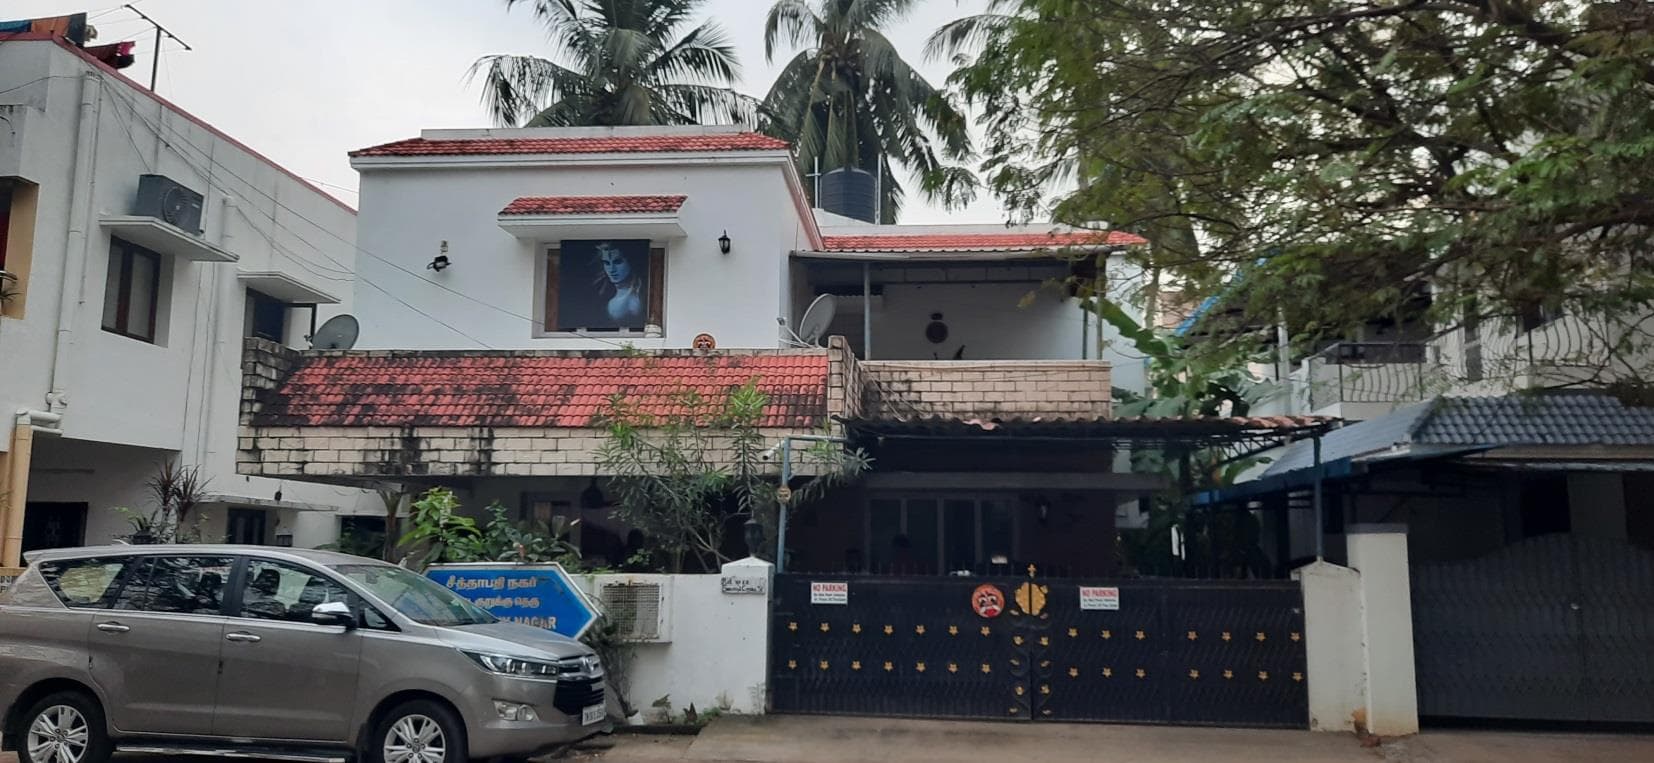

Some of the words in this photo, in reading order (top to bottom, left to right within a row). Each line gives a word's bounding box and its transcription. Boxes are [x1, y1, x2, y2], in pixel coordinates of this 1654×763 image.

[507, 576, 537, 590] நகர்
[813, 584, 821, 592] NO
[822, 584, 847, 592] PARKING
[1082, 589, 1090, 597] NO
[1092, 589, 1117, 597] PARKING
[514, 616, 557, 630] NAGAR
